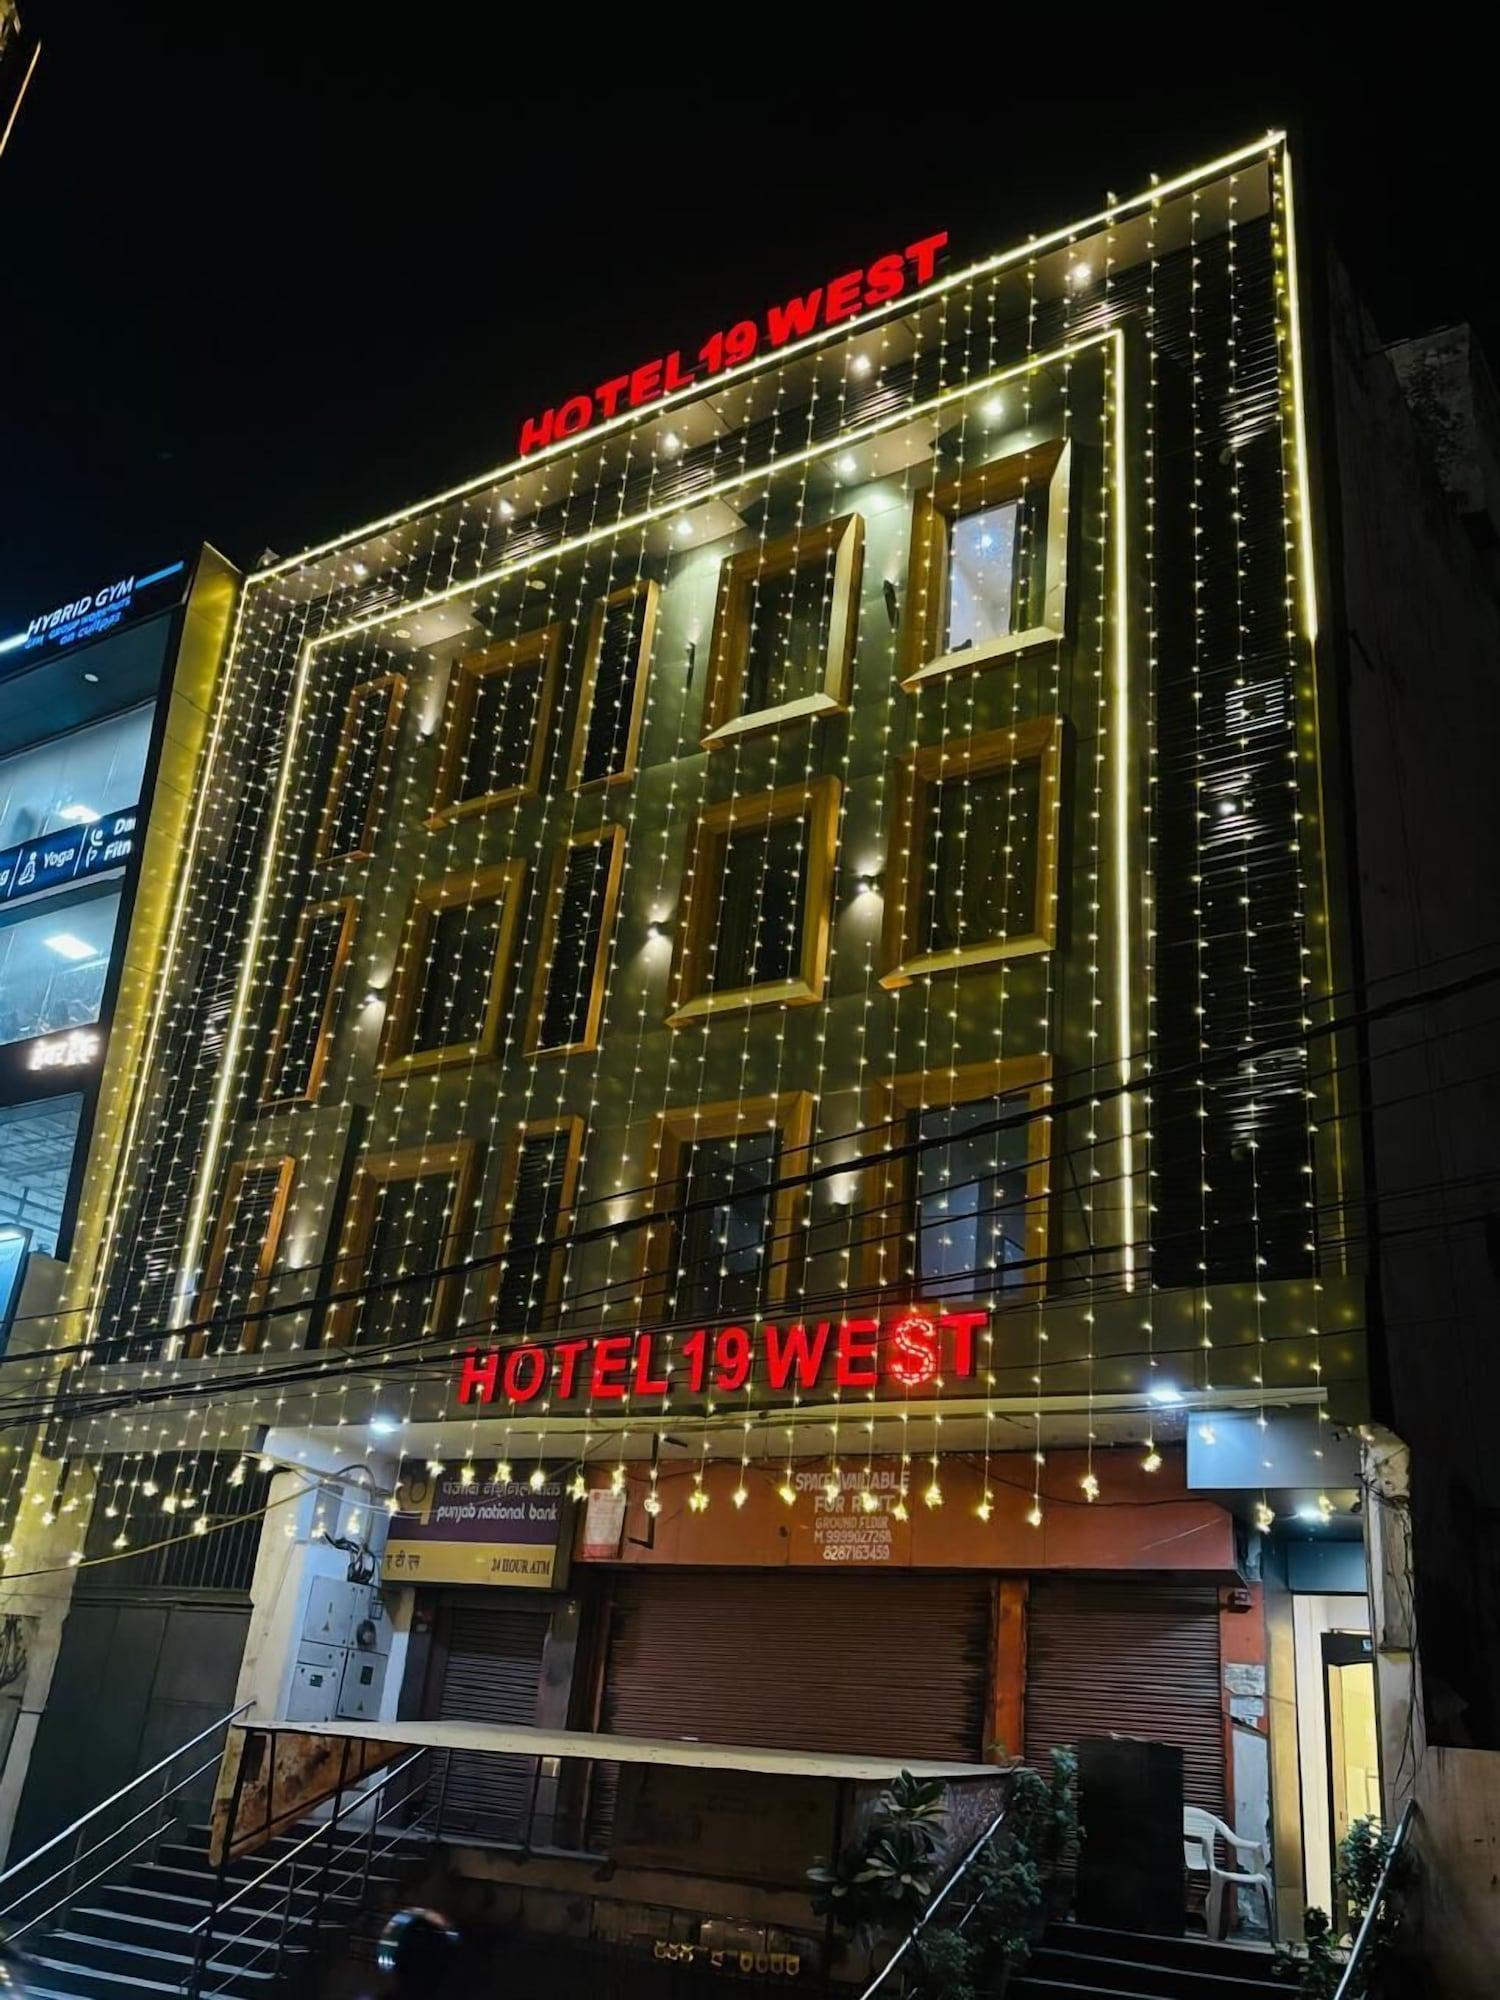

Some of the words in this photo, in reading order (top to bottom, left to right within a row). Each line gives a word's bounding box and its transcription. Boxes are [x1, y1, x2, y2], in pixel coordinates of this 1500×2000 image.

[518, 350, 695, 454] HOTEL
[700, 320, 757, 374] 19
[767, 231, 948, 346] WEST
[27, 596, 92, 638] HYBRID
[95, 575, 135, 607] GYM
[44, 848, 75, 869] Yoga
[459, 1334, 668, 1405] HOTEL
[683, 1326, 751, 1392] 19
[765, 1311, 988, 1390] WEST
[795, 1472, 832, 1491] SPACE
[436, 1503, 476, 1523] punjab
[477, 1502, 526, 1520] national
[528, 1503, 559, 1521] bank
[814, 1495, 845, 1513] FOR
[851, 1494, 896, 1513] RNT
[815, 1517, 857, 1530] GROUND
[859, 1515, 890, 1529] FLOOR
[502, 1558, 529, 1573] HOUR
[530, 1560, 551, 1575] ATM
